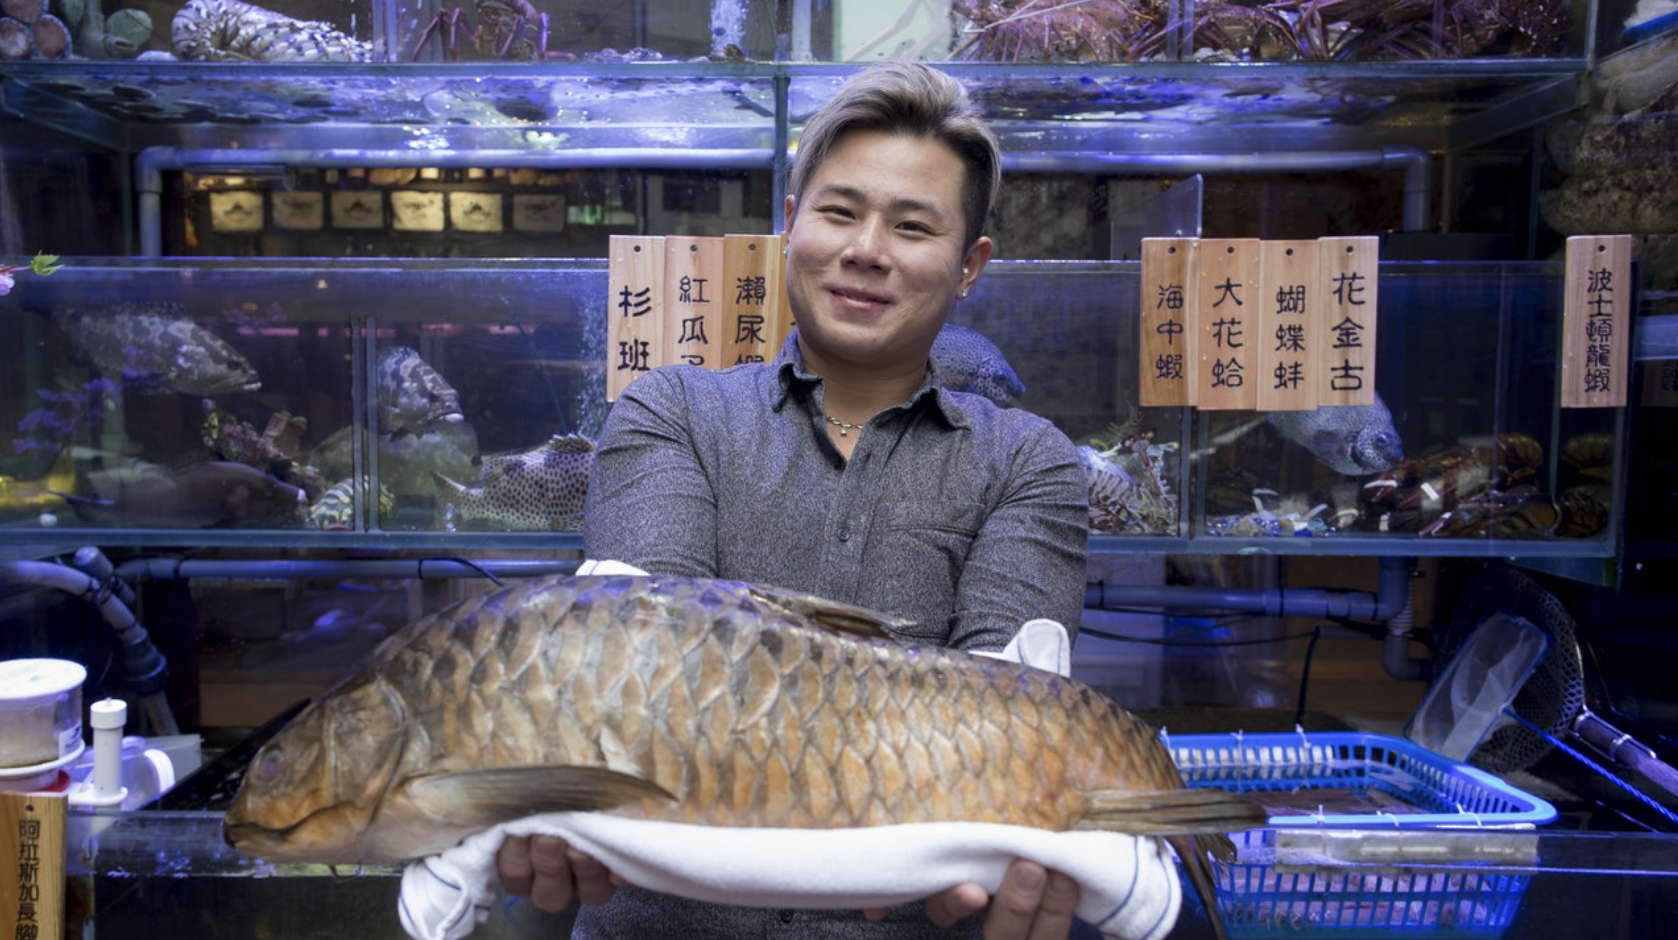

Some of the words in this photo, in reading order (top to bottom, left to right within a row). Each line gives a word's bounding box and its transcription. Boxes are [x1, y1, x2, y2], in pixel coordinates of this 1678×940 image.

[617, 285, 652, 371] 杉班
[1155, 284, 1184, 379] 海中蝦
[1211, 277, 1244, 388] 大花蛤
[1274, 285, 1306, 390] 蝴蝶蚌
[1330, 272, 1366, 391] 花金古
[1584, 268, 1613, 392] 波士頓龍蝦
